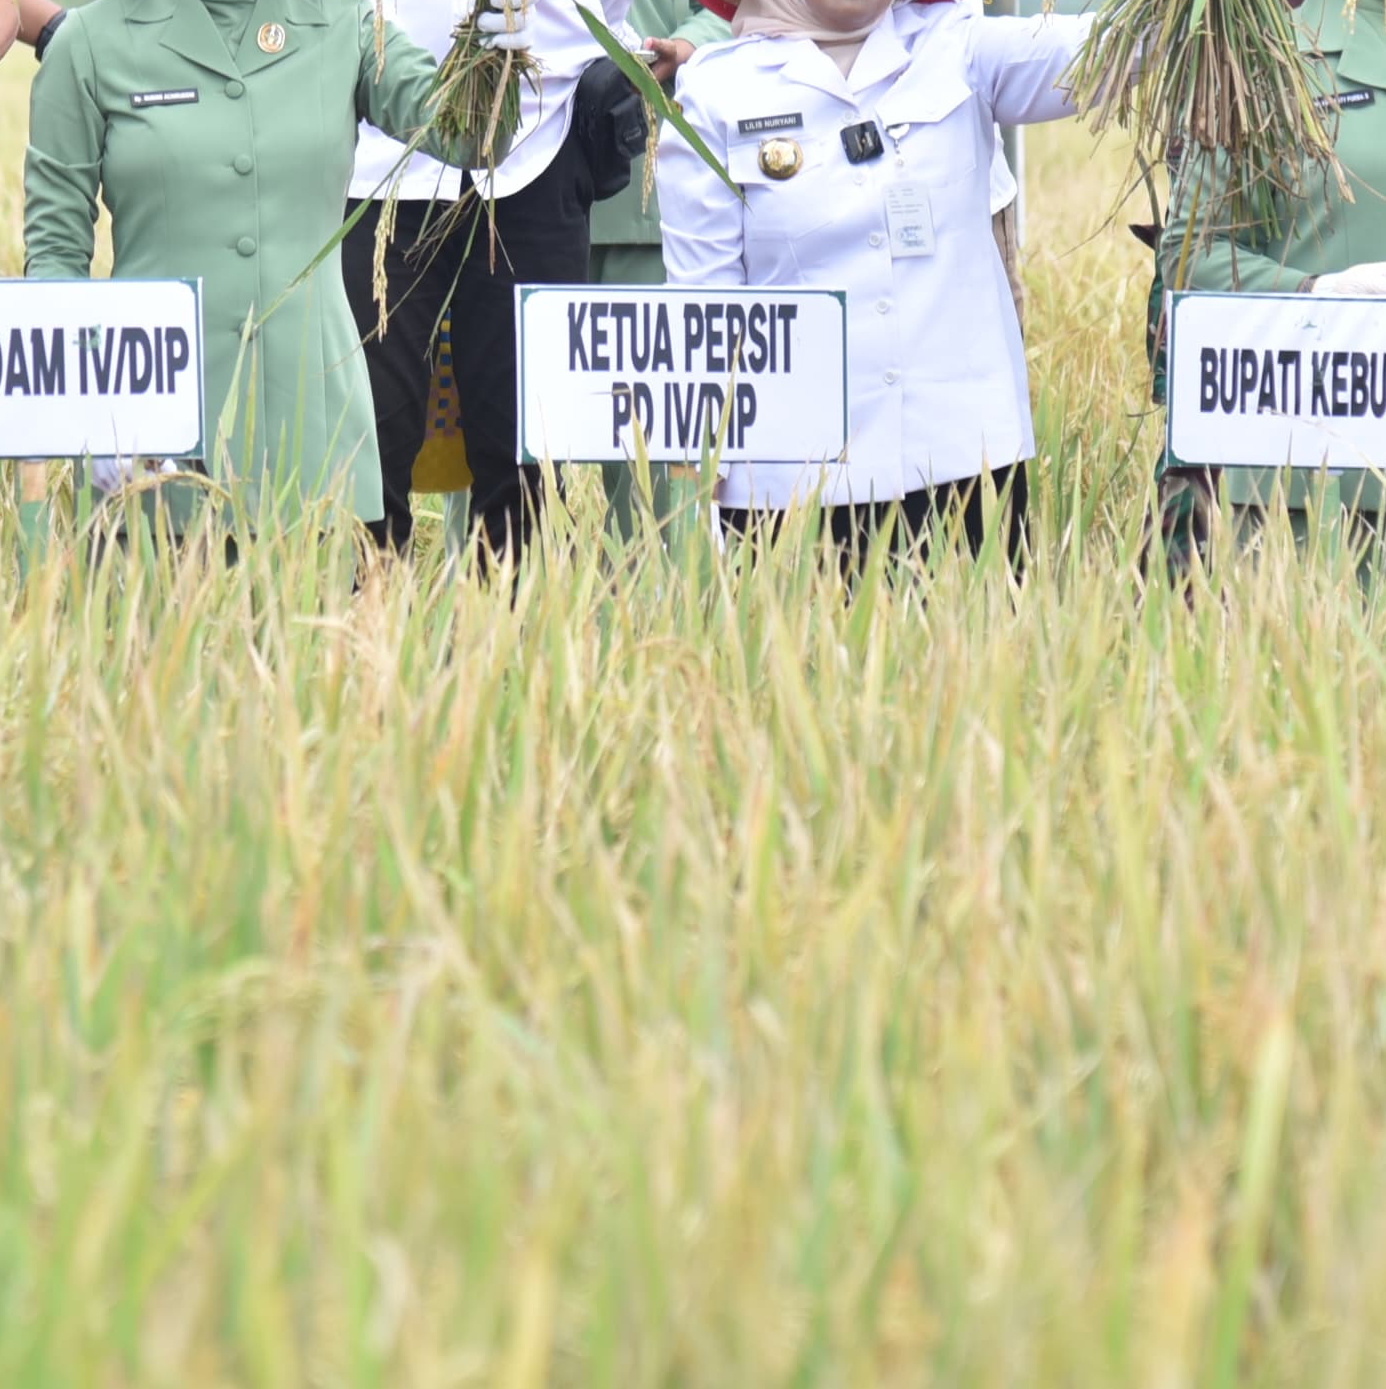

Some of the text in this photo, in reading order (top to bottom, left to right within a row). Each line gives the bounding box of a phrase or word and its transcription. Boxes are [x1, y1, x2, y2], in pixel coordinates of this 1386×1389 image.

[77, 325, 190, 395] IV/DIP
[567, 302, 798, 374] KETUA PERSIT
[612, 382, 654, 449] PD
[1199, 347, 1303, 416] BUPATI
